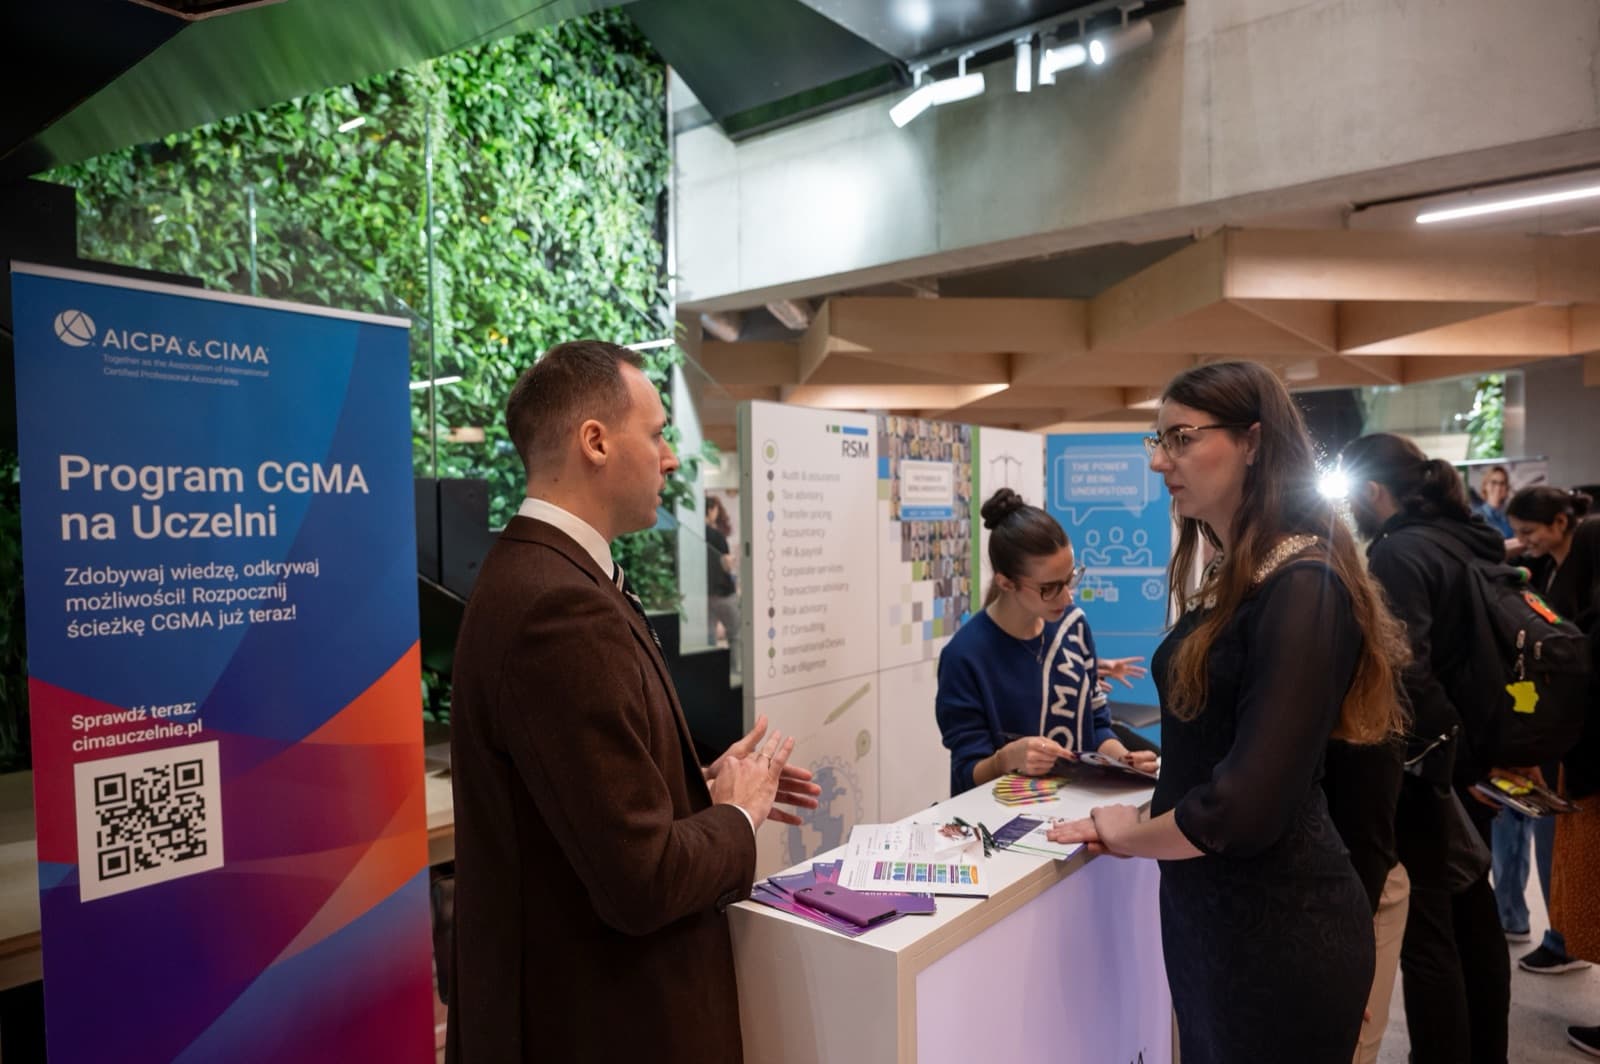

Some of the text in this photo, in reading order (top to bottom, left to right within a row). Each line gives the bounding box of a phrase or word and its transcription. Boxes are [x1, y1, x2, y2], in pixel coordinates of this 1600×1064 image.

[102, 329, 268, 364] AICPA & CIMA
[103, 354, 139, 366] Together
[841, 440, 869, 459] RSM
[59, 455, 369, 500] Program CGMA
[61, 504, 277, 540] na Uczelni
[64, 558, 319, 587] Zdobywaj wiedzę, odkrywaj
[66, 582, 287, 612] możliwości! Rozpocznij
[67, 604, 296, 638] ścieżkę CGMA już teraz!
[71, 701, 197, 732] Sprawdź teraz:
[72, 718, 203, 752] cimauczelnie.pl
